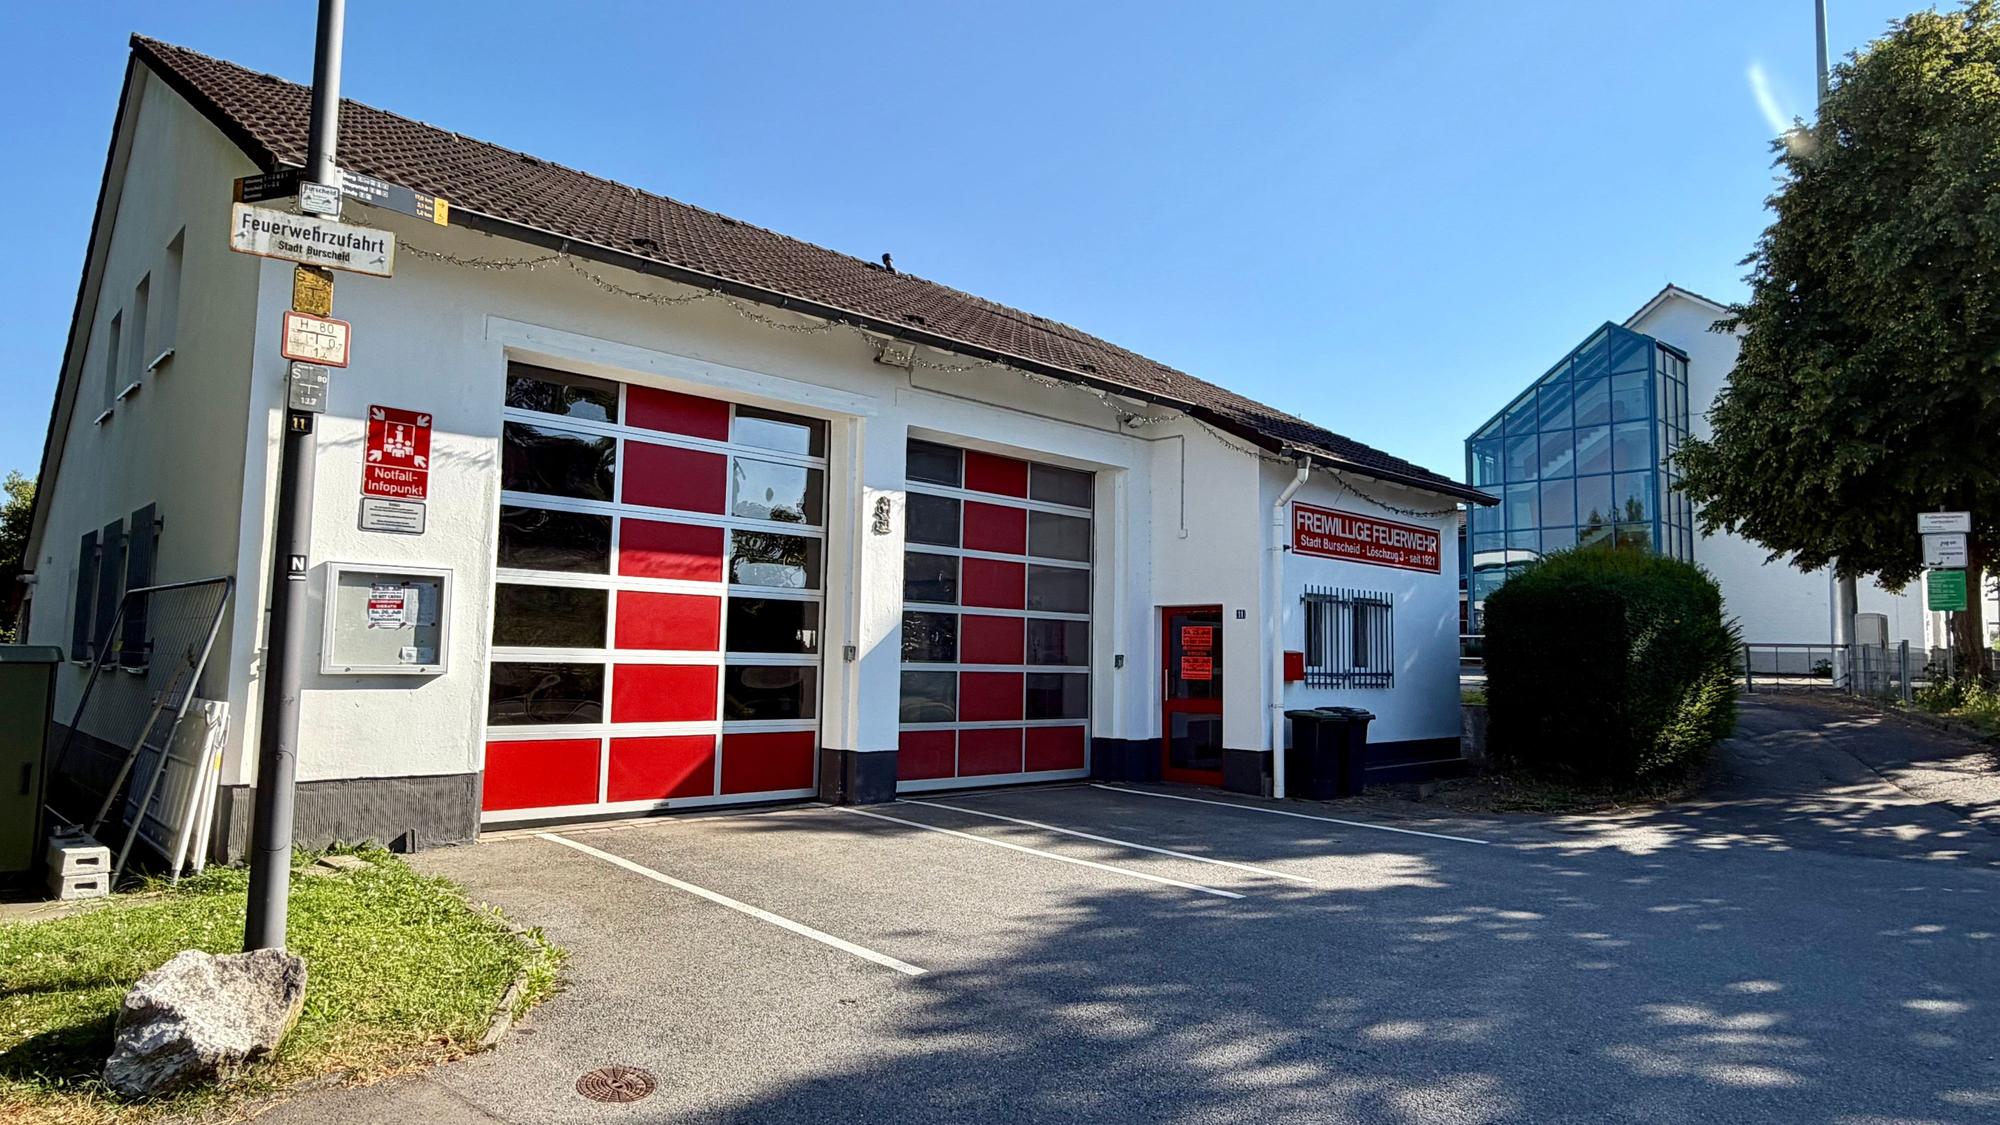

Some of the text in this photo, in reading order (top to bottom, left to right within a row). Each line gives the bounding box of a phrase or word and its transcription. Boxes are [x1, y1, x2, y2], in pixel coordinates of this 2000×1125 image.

[242, 213, 384, 254] Feuerwehrzufahrt
[278, 240, 350, 262] Stadt Burscheid
[300, 319, 335, 335] H 80
[292, 368, 328, 384] S 80
[293, 417, 305, 430] 11
[374, 467, 418, 482] Notfall-
[368, 480, 423, 496] Infopunkt
[1296, 510, 1437, 553] FREIWILLIGE FEUERWEHR
[1300, 534, 1322, 549] Stadt
[1323, 538, 1361, 555] Burscheid
[1366, 545, 1399, 563] Löschzug
[1399, 550, 1405, 562] 3
[1409, 554, 1421, 565] seit
[1422, 554, 1436, 566] 1921
[292, 556, 305, 571] N
